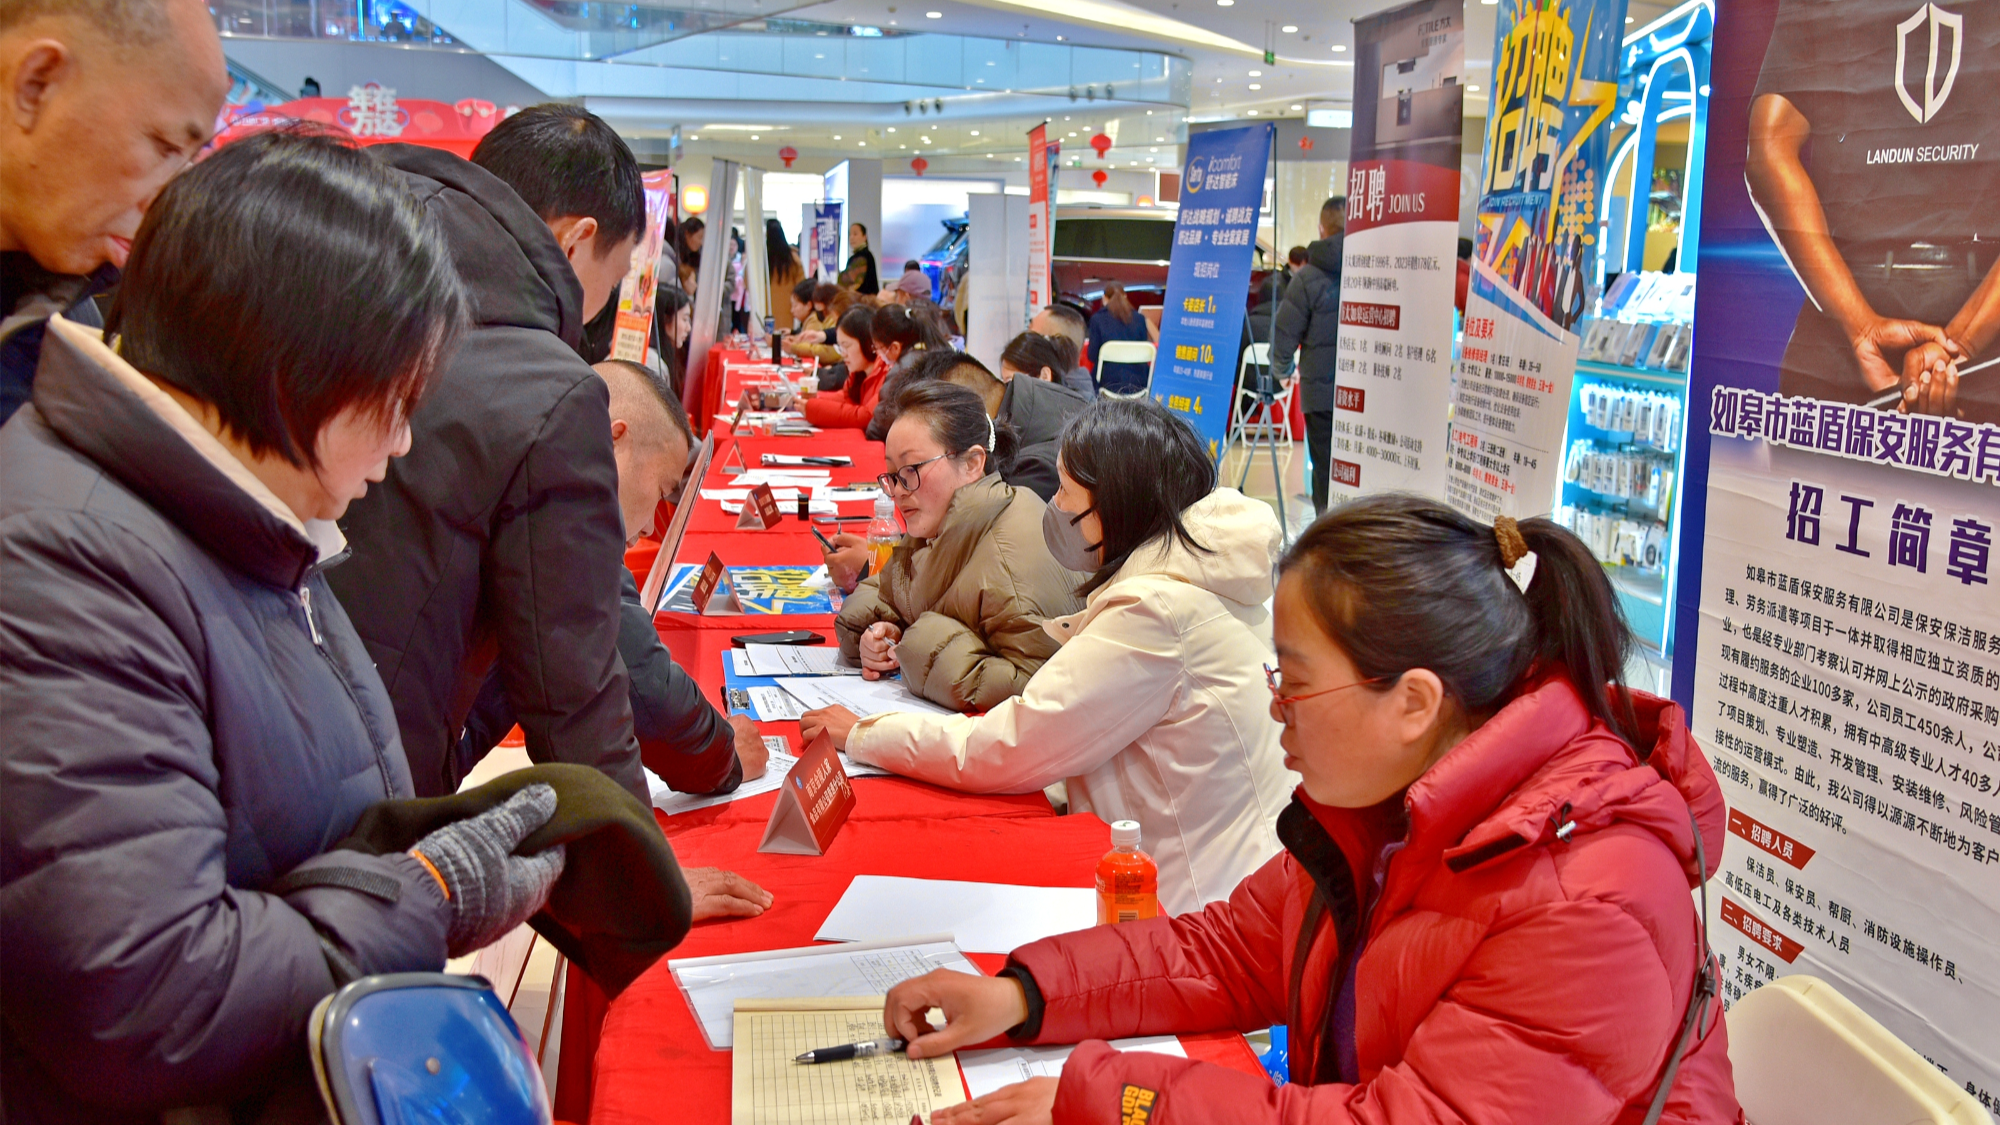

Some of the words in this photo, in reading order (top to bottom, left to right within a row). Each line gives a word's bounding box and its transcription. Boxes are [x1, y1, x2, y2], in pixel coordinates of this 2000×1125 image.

[1483, 8, 1574, 194] 招聘
[1348, 164, 1386, 221] 招聘
[1388, 194, 1410, 213] JOIN
[1412, 192, 1425, 213] US
[1487, 195, 1501, 208] JOIN
[1866, 148, 1914, 165] LANDUN
[1915, 144, 1979, 163] SECURITY
[1425, 348, 1436, 363] 6名
[1711, 387, 2000, 484] 如皋市蓝盾保安服务有
[1785, 481, 1991, 586] 招工简章
[1725, 588, 2000, 691] 理、劳务派遣等项目于一体并取得相应独立资质的
[1746, 563, 2000, 656] 如皋市蓝盾保安服务有限公司是保安保洁服务
[1721, 643, 2000, 762] 现有履约服务的企业100多家，公司员工450余人，公
[1722, 616, 2000, 727] 业，也是经专业部门考察认可并网上公示的政府采购
[1713, 755, 1847, 835] 流的服务，赢得了广泛的好评。
[1715, 728, 2000, 866] 接性的运营模式。由此，我公司得以源源不断地为客户
[1718, 700, 2000, 836] 了项目策划、专业塑造、开发管理、安装维修、风险管
[1731, 817, 1794, 860] 一、招聘人员
[1724, 903, 1783, 952] 二、招聘要求
[1725, 870, 1850, 954] 高低压电工及各类技术人员
[1746, 855, 1964, 985] 保洁员、保安员、帮厨、消防设施操作员、
